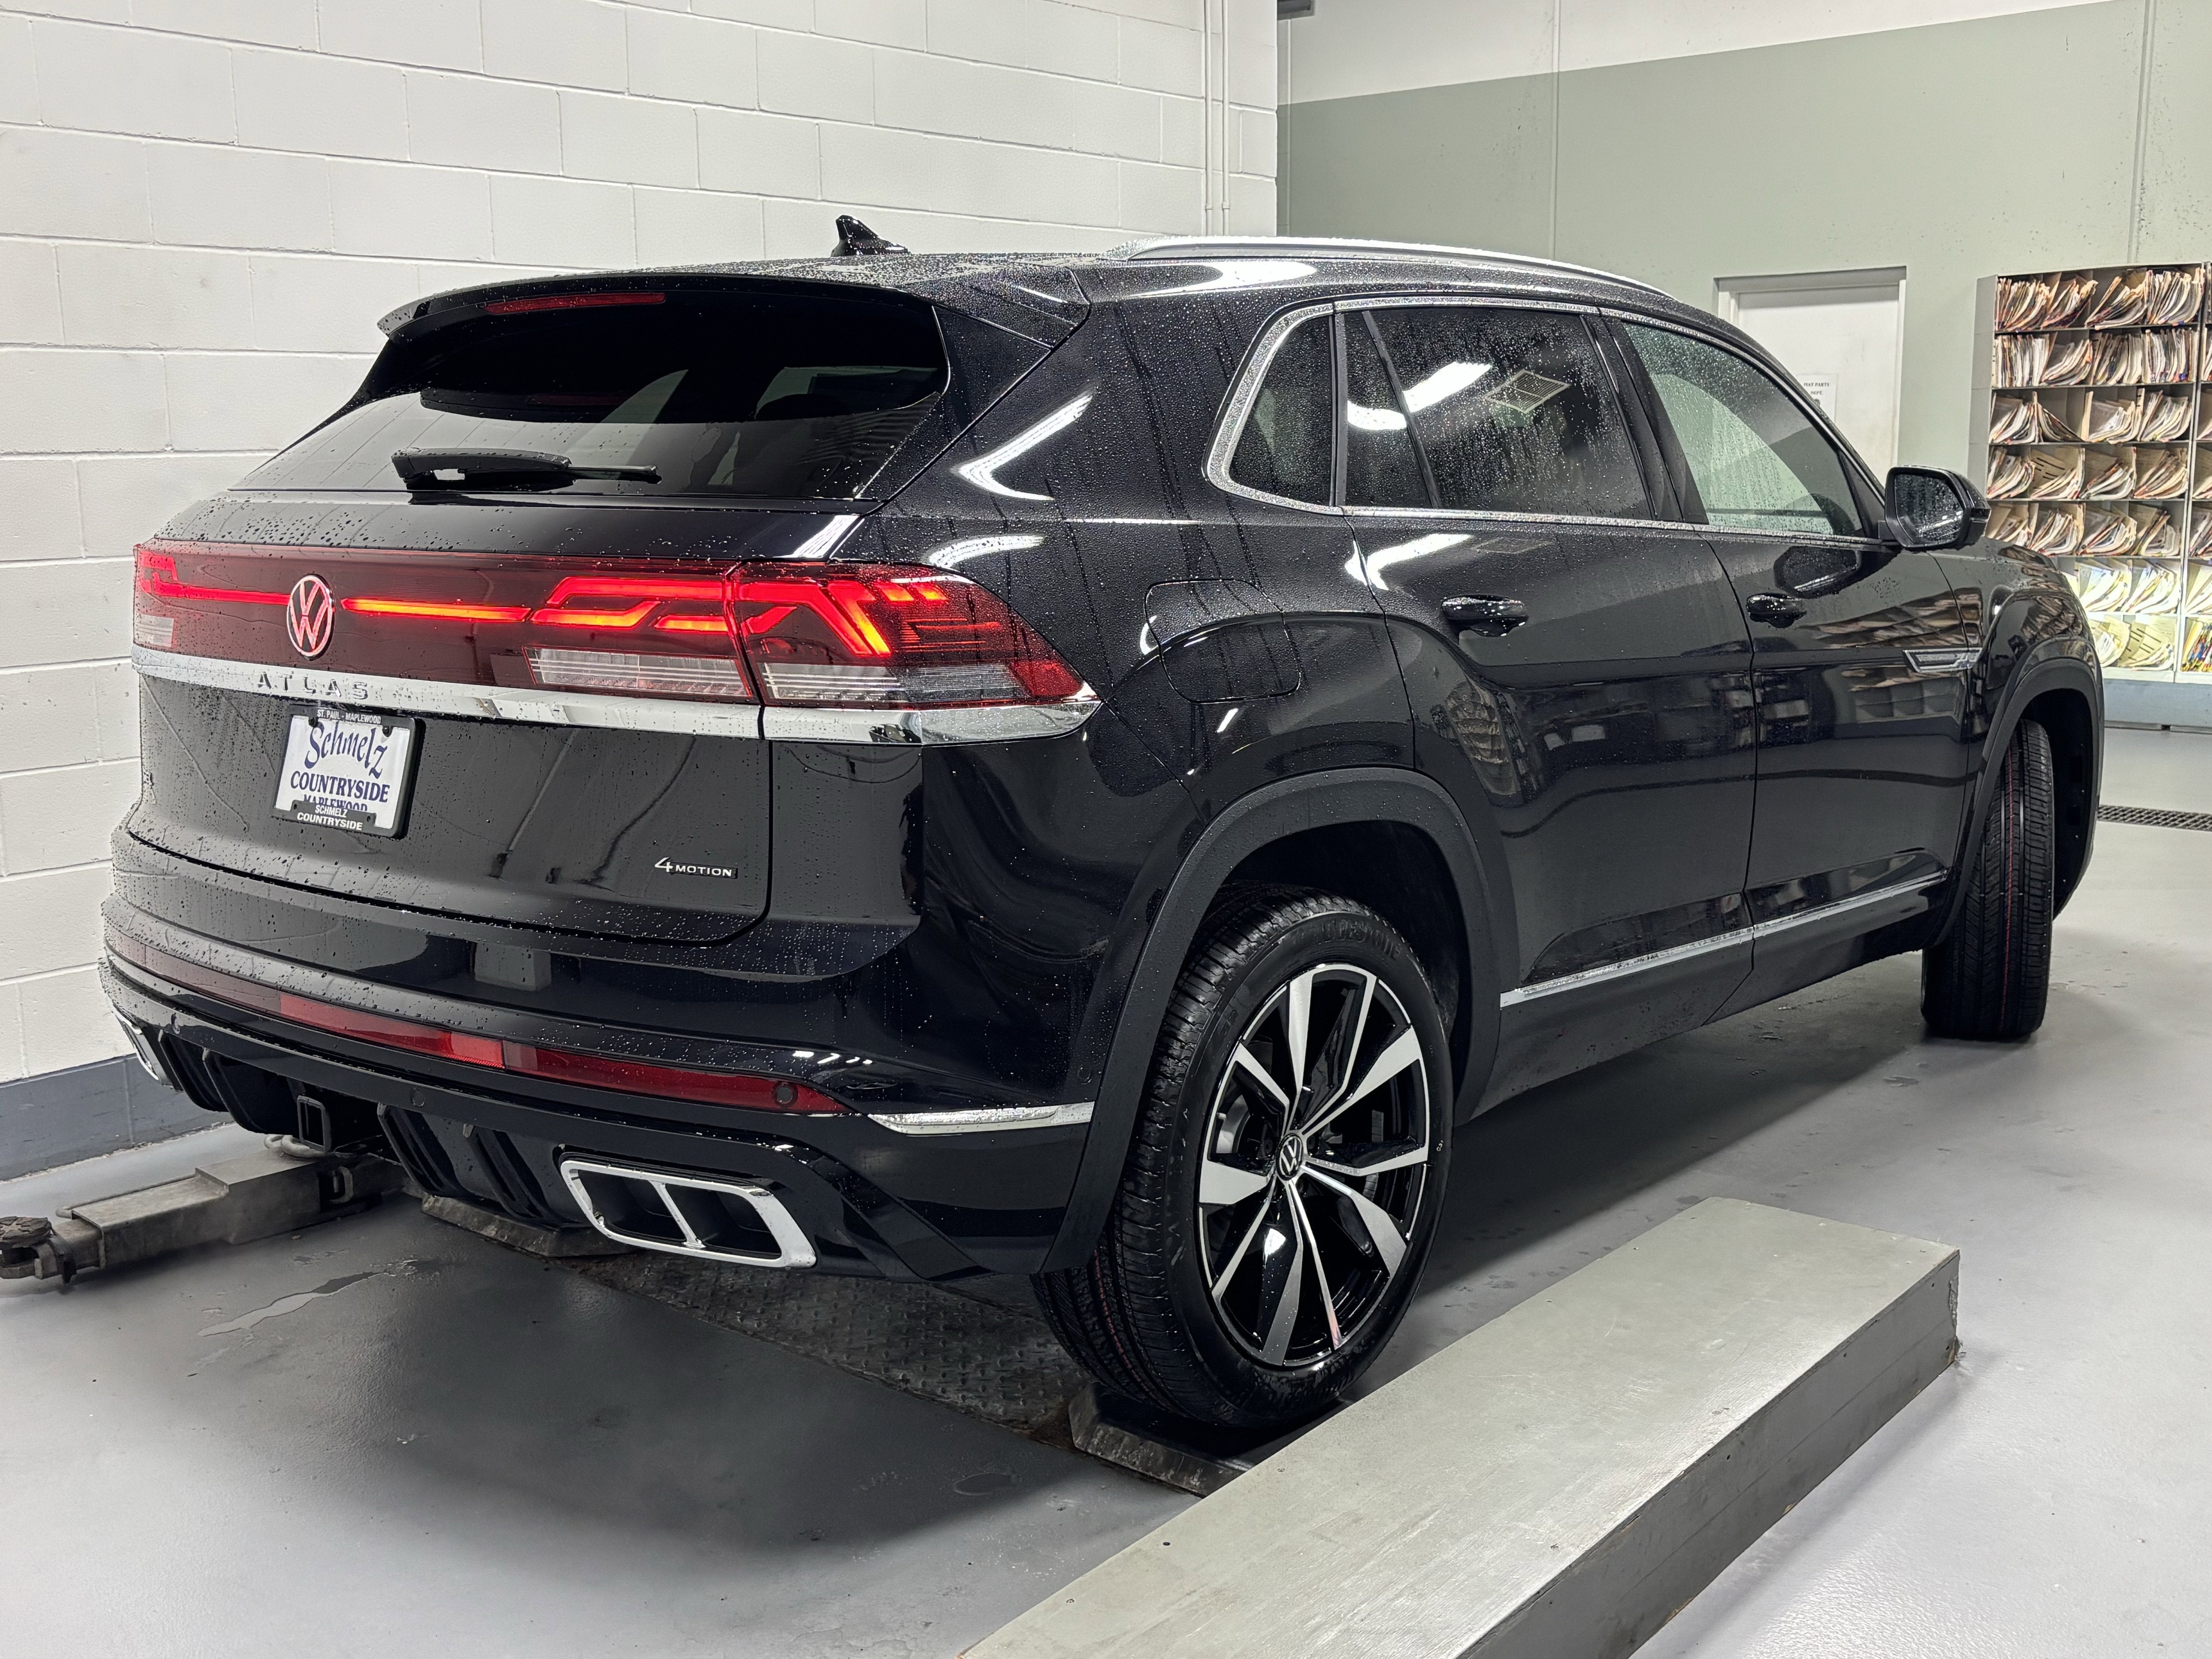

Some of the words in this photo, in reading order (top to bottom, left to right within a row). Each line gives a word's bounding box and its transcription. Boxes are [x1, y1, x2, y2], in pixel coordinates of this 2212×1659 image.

[256, 671, 368, 700] ATLAS
[317, 709, 325, 718] ST.
[326, 710, 340, 720] PAUL
[345, 712, 381, 724] MAPLEWOOD
[304, 721, 388, 779] Schmelz
[290, 771, 390, 803] COUNTRYSIDE
[315, 804, 348, 818] SCHMELZ
[297, 812, 363, 831] COUNTRYSIDE
[654, 857, 732, 877] 4MOTION
